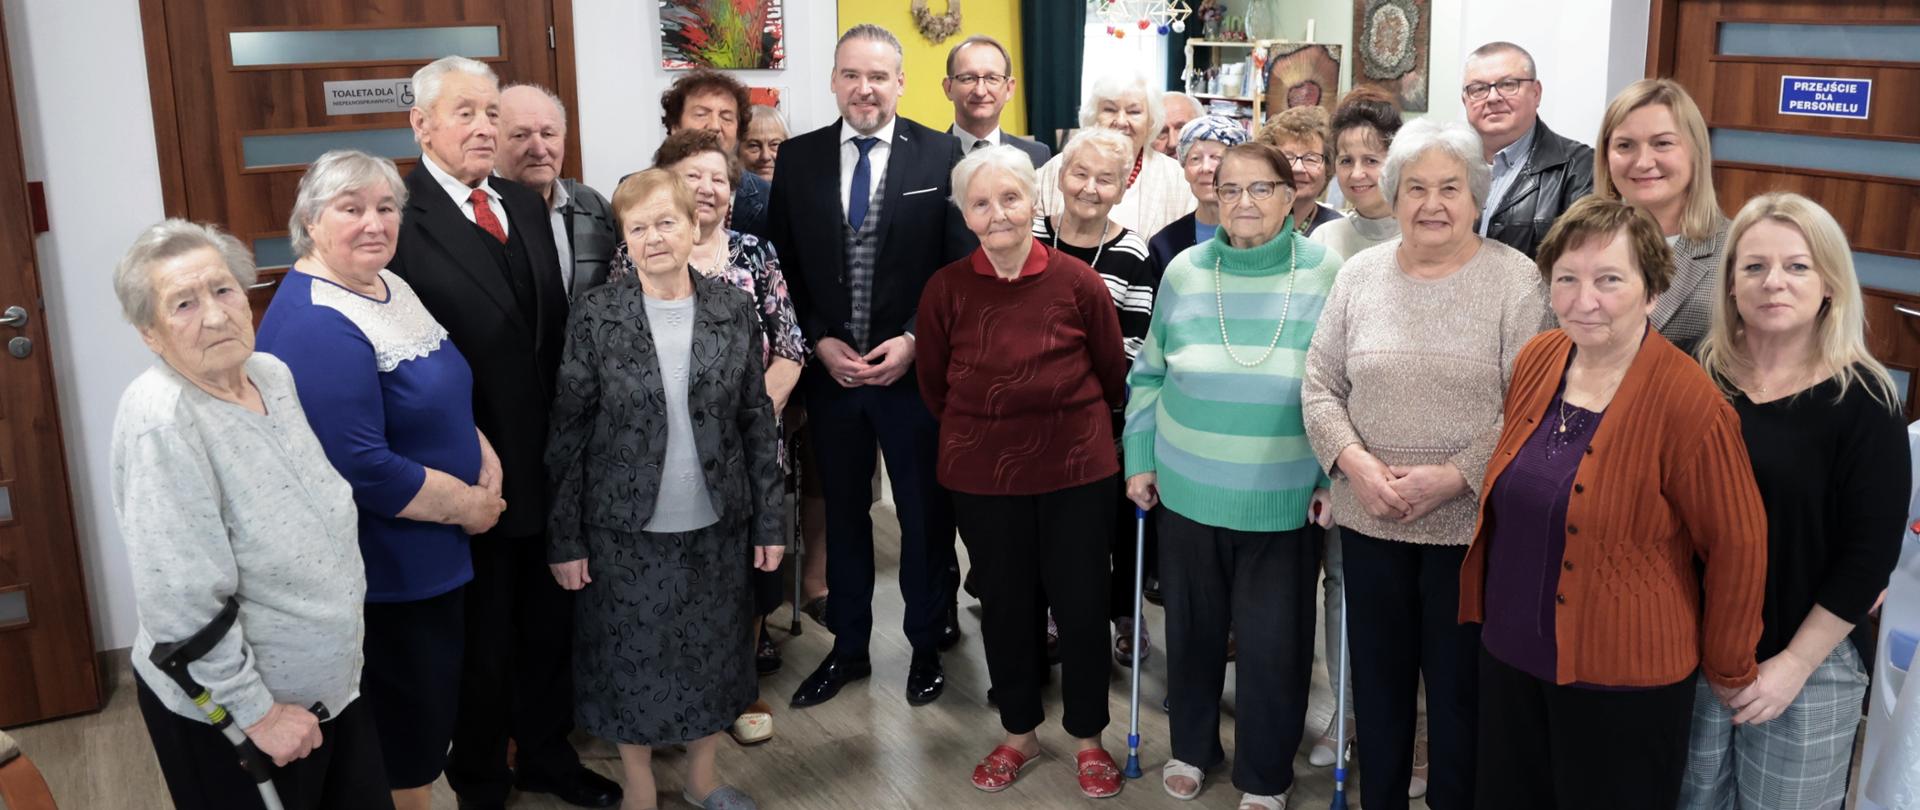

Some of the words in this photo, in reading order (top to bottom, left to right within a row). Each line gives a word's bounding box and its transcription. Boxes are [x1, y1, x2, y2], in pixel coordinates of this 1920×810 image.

[1794, 82, 1857, 93] PRZEJŚCIE
[333, 89, 373, 98] TOALETA
[375, 88, 394, 96] DLA
[1815, 93, 1833, 101] DLA
[1789, 101, 1858, 113] PERSONELU
